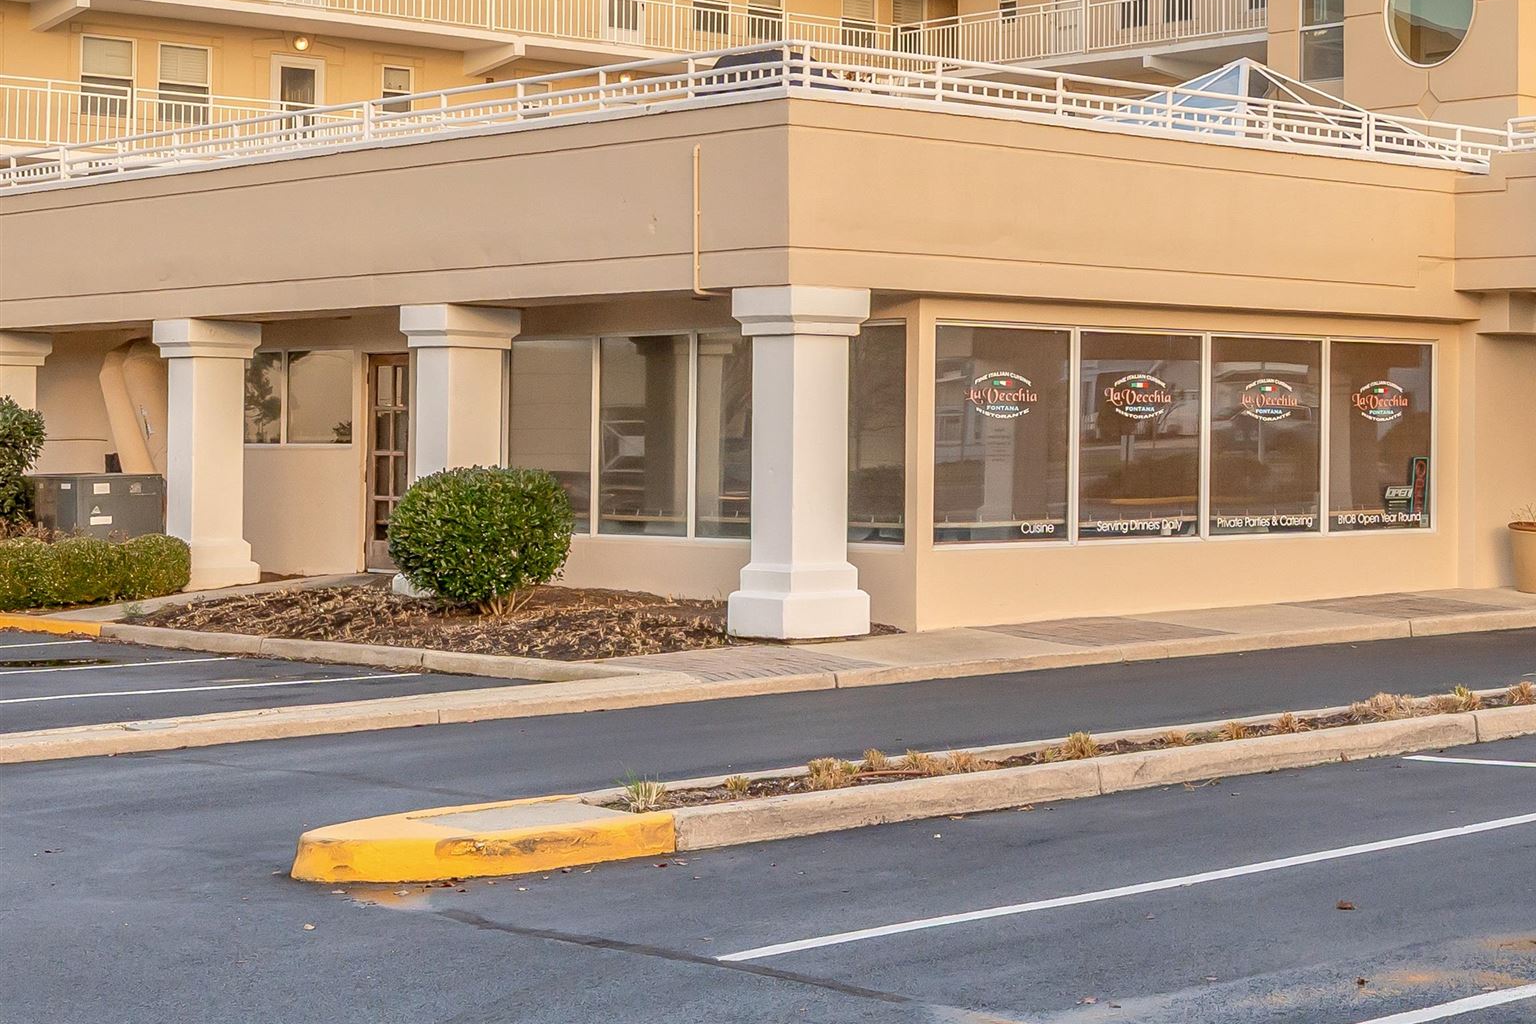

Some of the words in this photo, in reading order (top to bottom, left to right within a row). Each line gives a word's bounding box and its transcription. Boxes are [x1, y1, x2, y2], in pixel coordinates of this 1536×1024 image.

[982, 387, 1038, 404] Vecchia
[1104, 387, 1123, 406] La
[1121, 389, 1172, 405] Vecchia
[1253, 393, 1297, 407] Vecchia
[1352, 393, 1367, 410] La
[1365, 394, 1408, 409] Vecchia
[976, 407, 1030, 419] RISTORANTE
[1115, 407, 1164, 419] RISTORANTE
[1388, 488, 1411, 497] OPEN
[1096, 520, 1129, 533] Serving
[1129, 519, 1160, 531] Dinners
[1161, 518, 1183, 531] Daily
[1216, 517, 1244, 528] Private
[1244, 516, 1271, 527] Parties
[1271, 515, 1279, 527] &
[1280, 515, 1313, 528] Catering
[1357, 513, 1380, 526] Open
[1380, 512, 1397, 523] Year
[1398, 511, 1421, 522] Round
[1020, 522, 1055, 534] Cuisine
